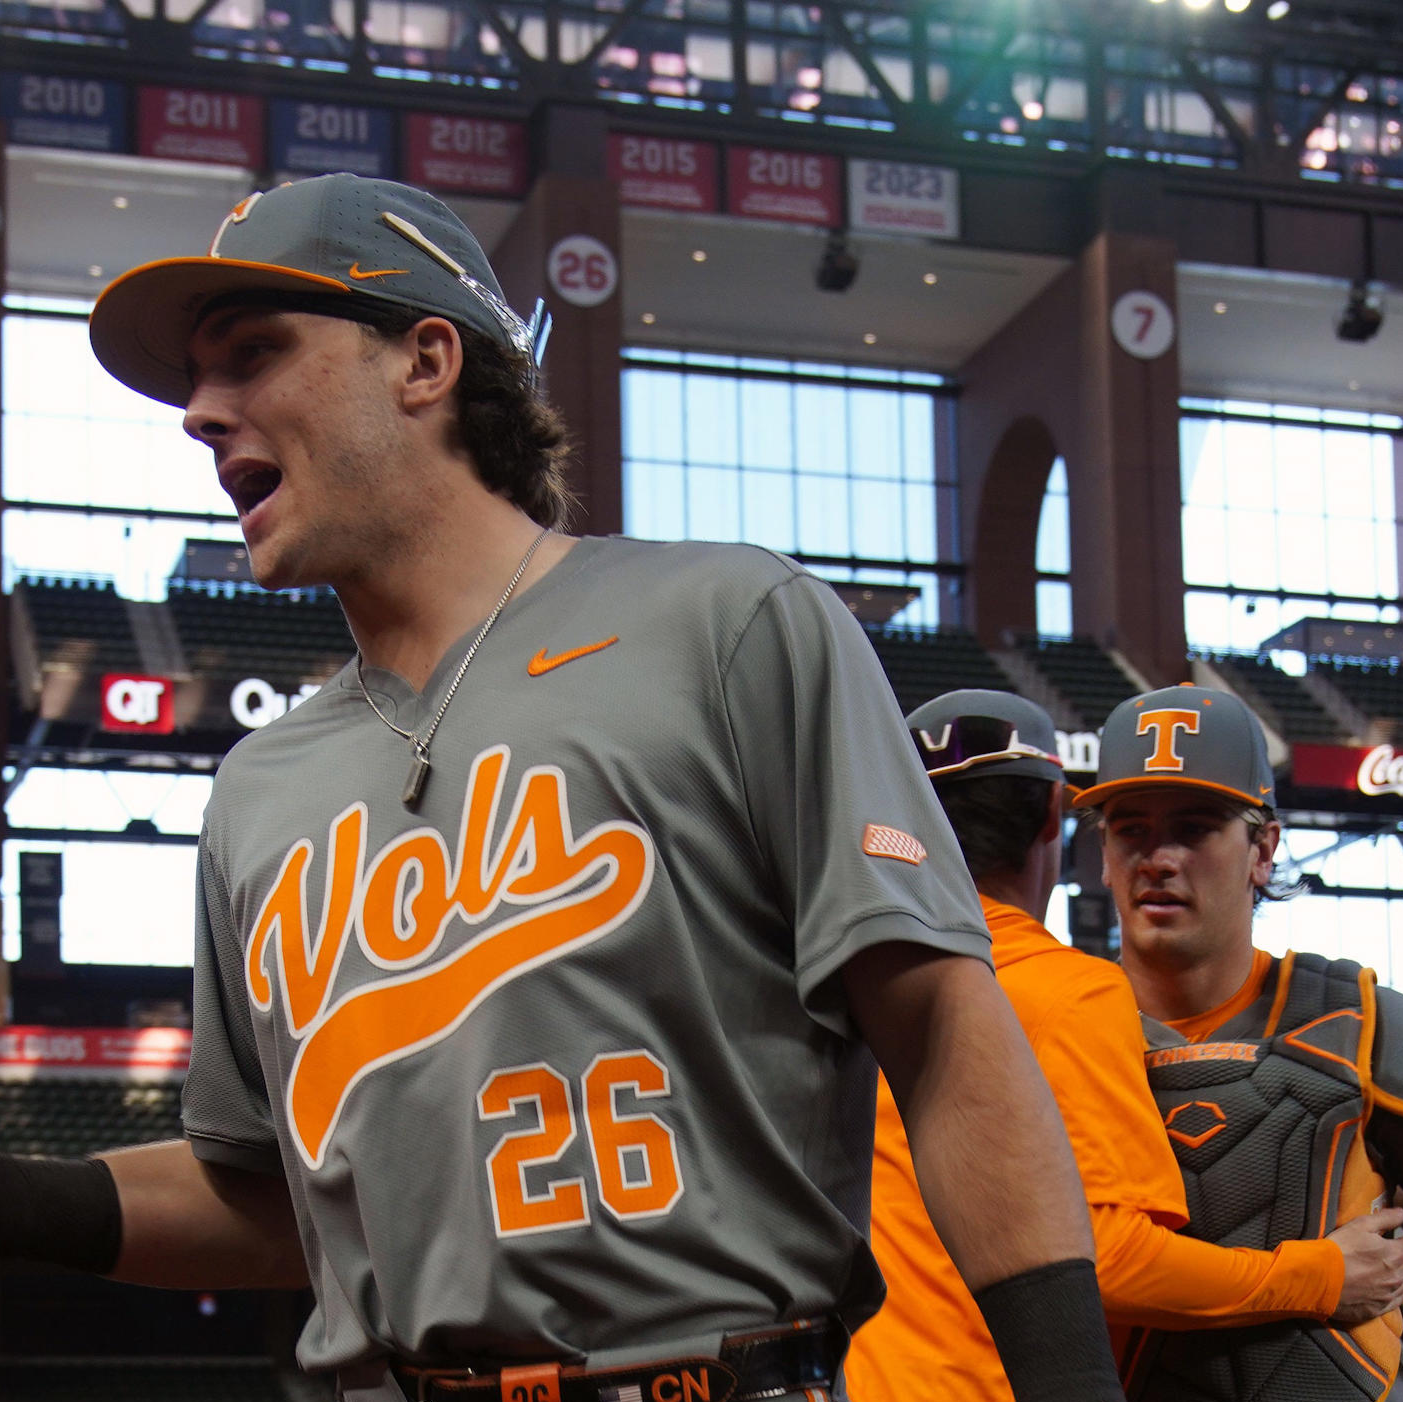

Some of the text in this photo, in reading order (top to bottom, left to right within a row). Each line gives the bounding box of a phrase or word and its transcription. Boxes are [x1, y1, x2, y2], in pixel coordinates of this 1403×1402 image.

[19, 75, 105, 117] 2010
[164, 89, 239, 131] 2011
[296, 103, 369, 144] 2011
[428, 117, 508, 158] 2012
[620, 137, 697, 176] 2015
[749, 151, 824, 189] 2016
[863, 164, 944, 201] 2023
[558, 252, 615, 291] 26
[1132, 305, 1155, 342] 7
[106, 678, 165, 725] QT
[1136, 707, 1201, 772] T
[245, 743, 654, 1171] Vols
[476, 1048, 686, 1239] 26
